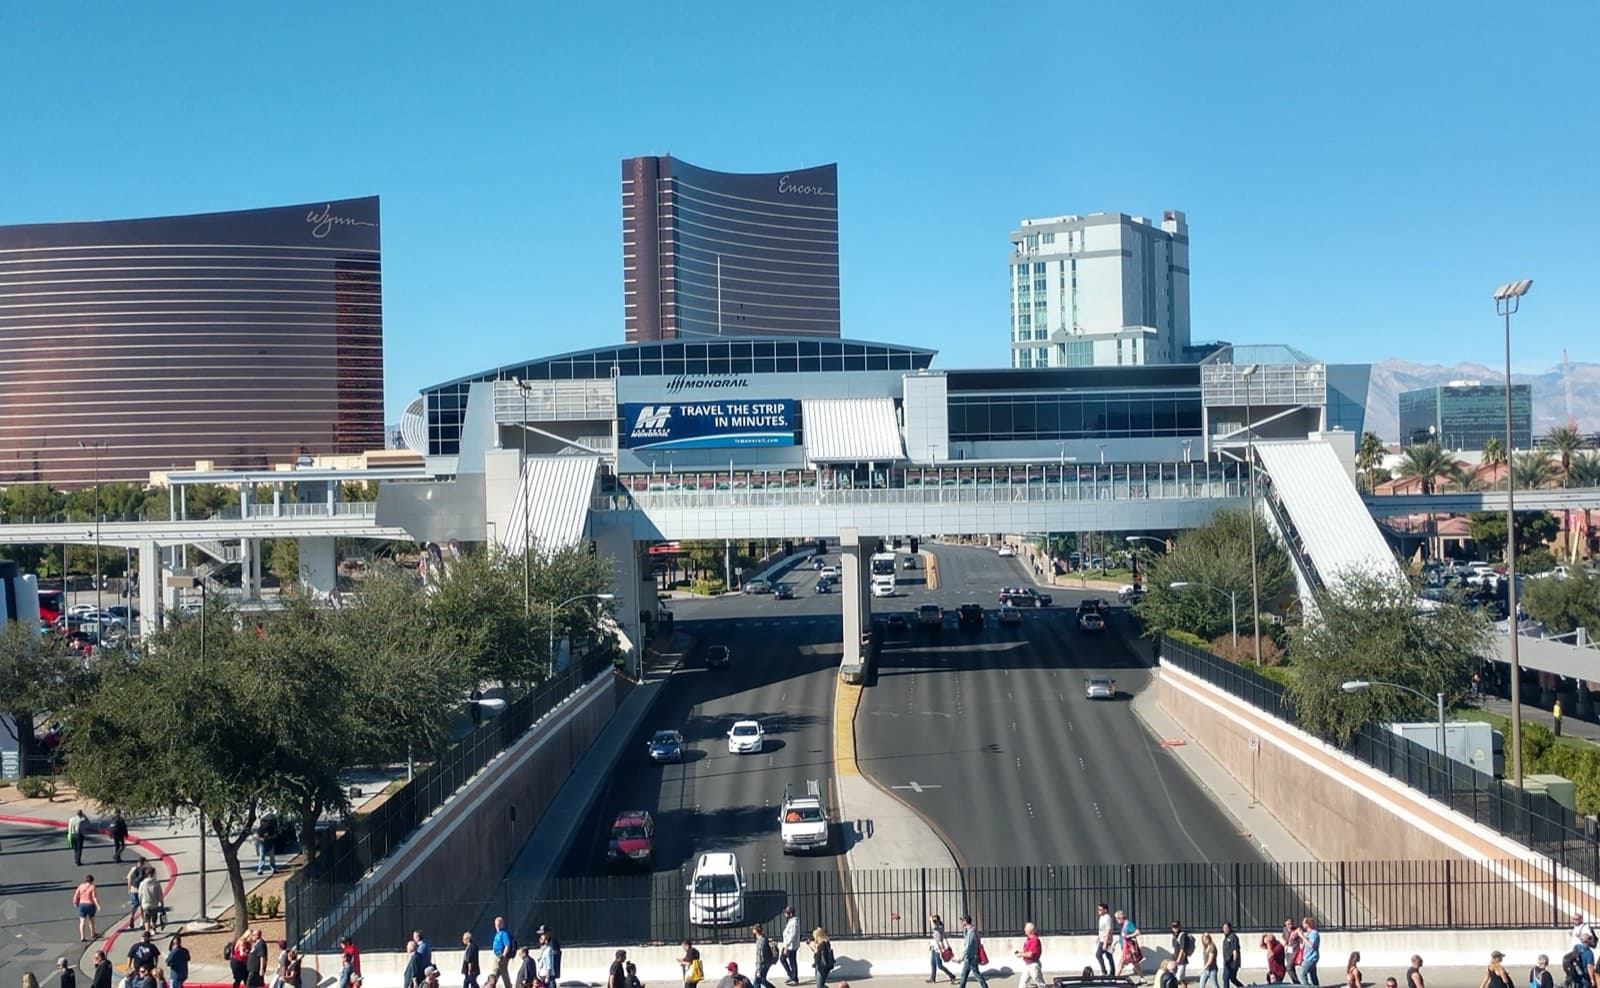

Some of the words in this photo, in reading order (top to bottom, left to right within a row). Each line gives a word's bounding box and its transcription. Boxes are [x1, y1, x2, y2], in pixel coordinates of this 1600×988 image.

[778, 175, 835, 196] Encore
[685, 379, 749, 389] MONORAIL
[681, 404, 723, 416] TRAVEL
[726, 404, 750, 416] THE
[751, 403, 785, 415] STRIP
[714, 417, 728, 428] IN
[731, 415, 788, 427] MINUTES.
